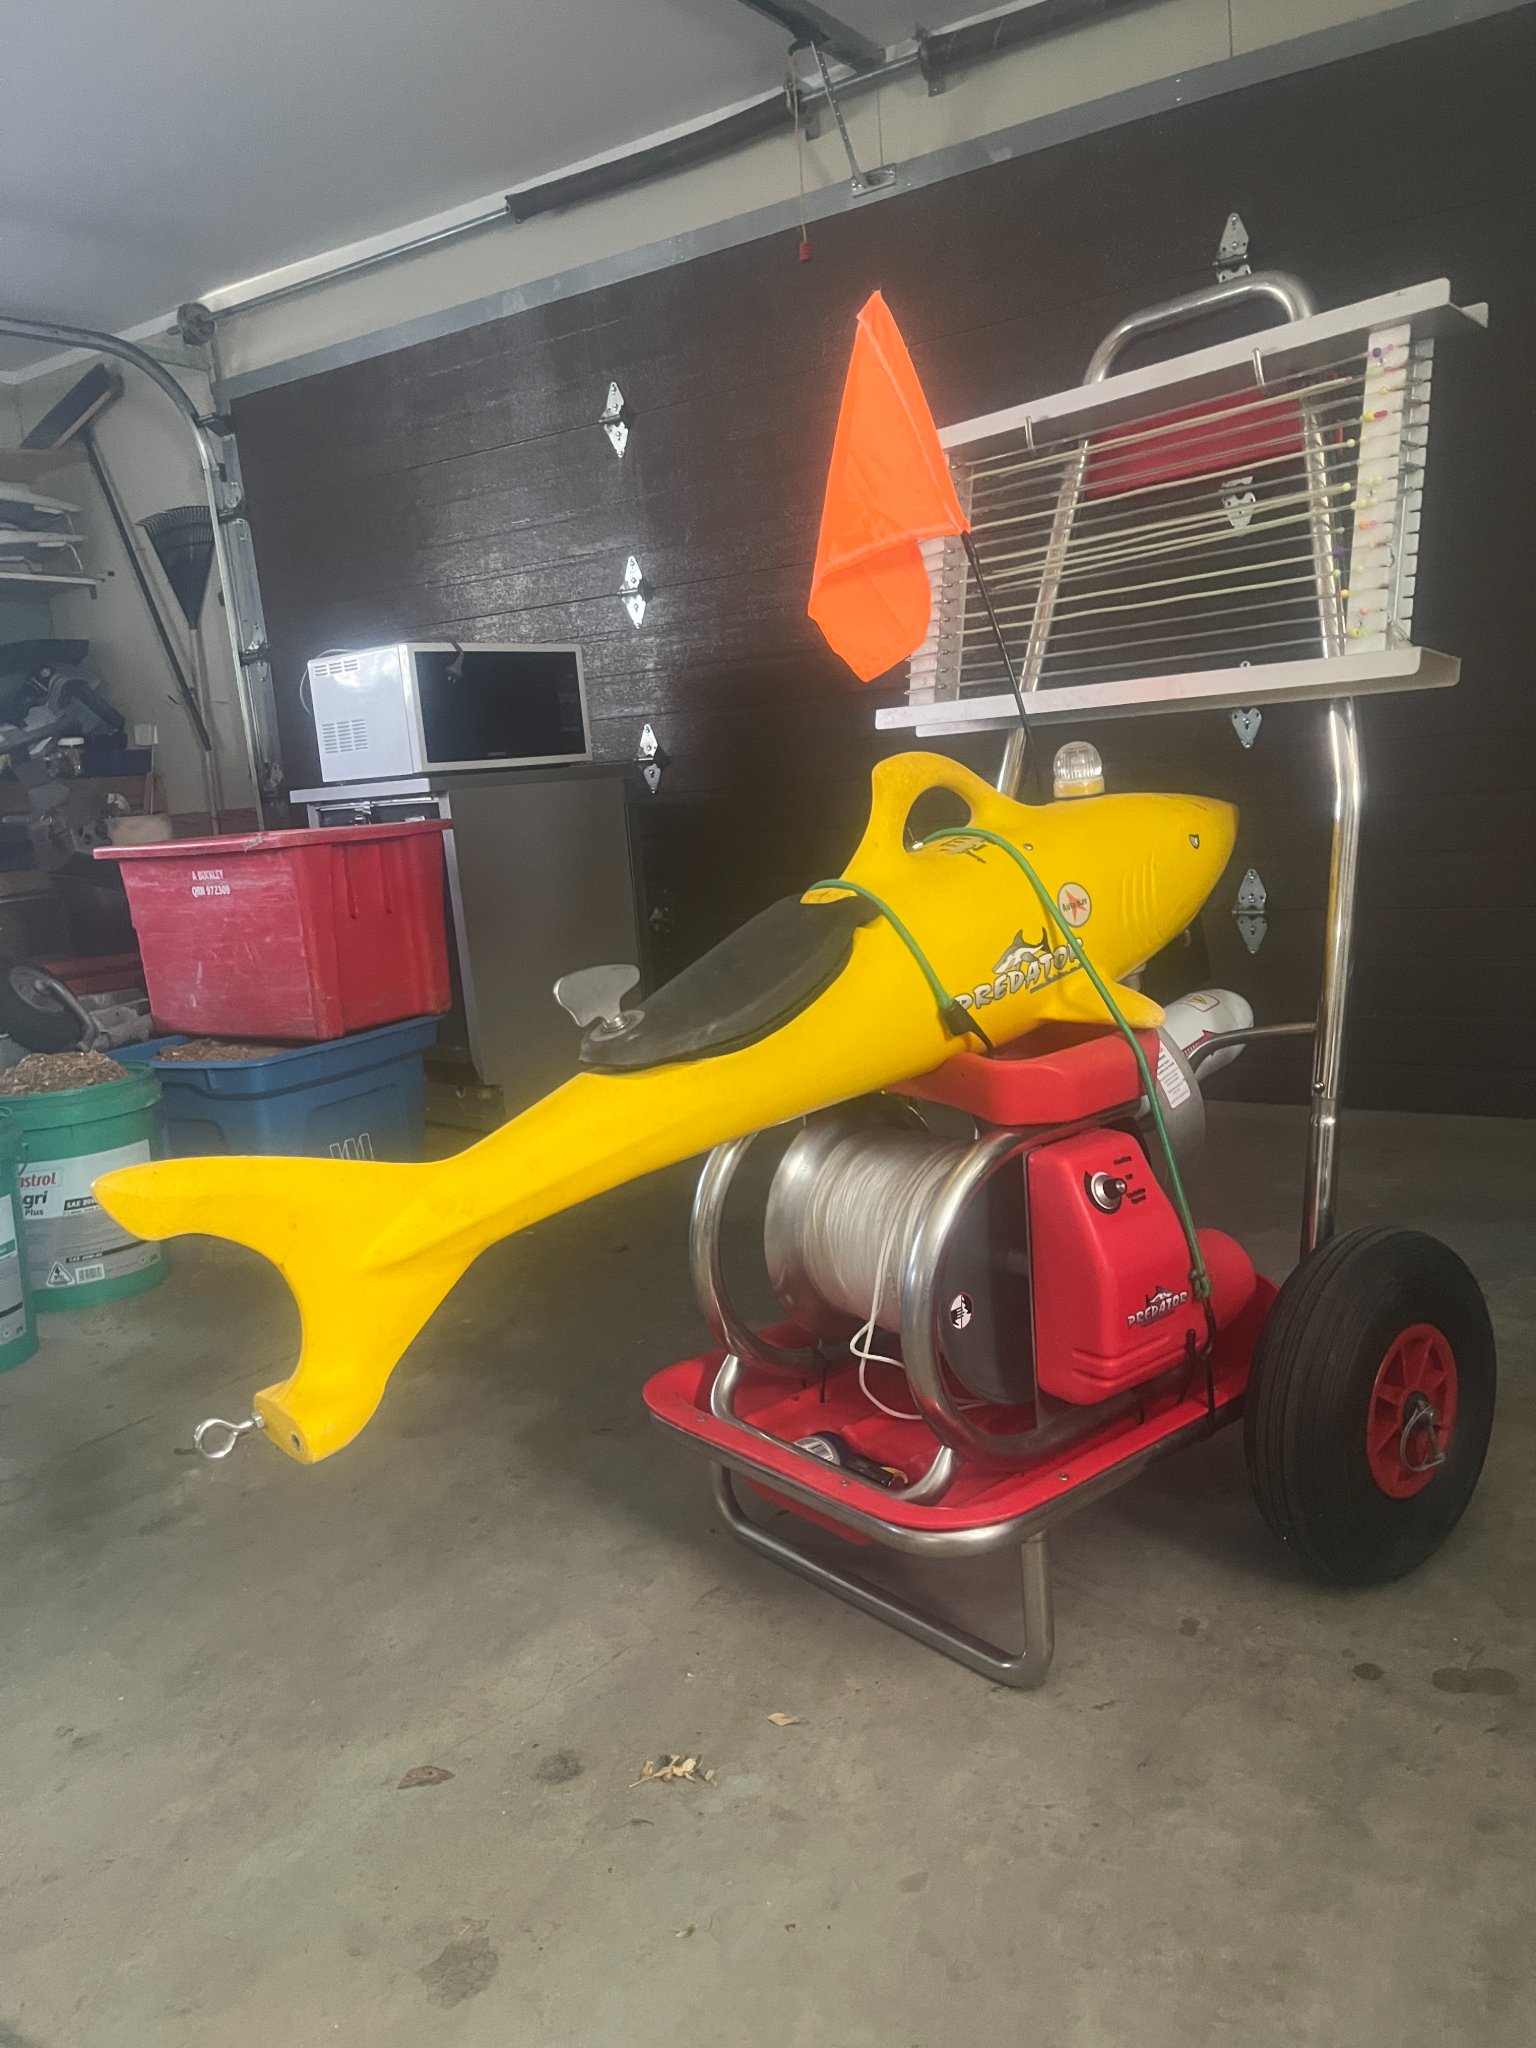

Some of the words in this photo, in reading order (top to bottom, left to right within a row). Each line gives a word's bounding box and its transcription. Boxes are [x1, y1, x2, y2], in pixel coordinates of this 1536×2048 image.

[18, 1171, 56, 1188] astrol
[22, 1190, 48, 1209] gri
[24, 1208, 44, 1217] Plus
[1127, 1291, 1188, 1328] PREDATOR
